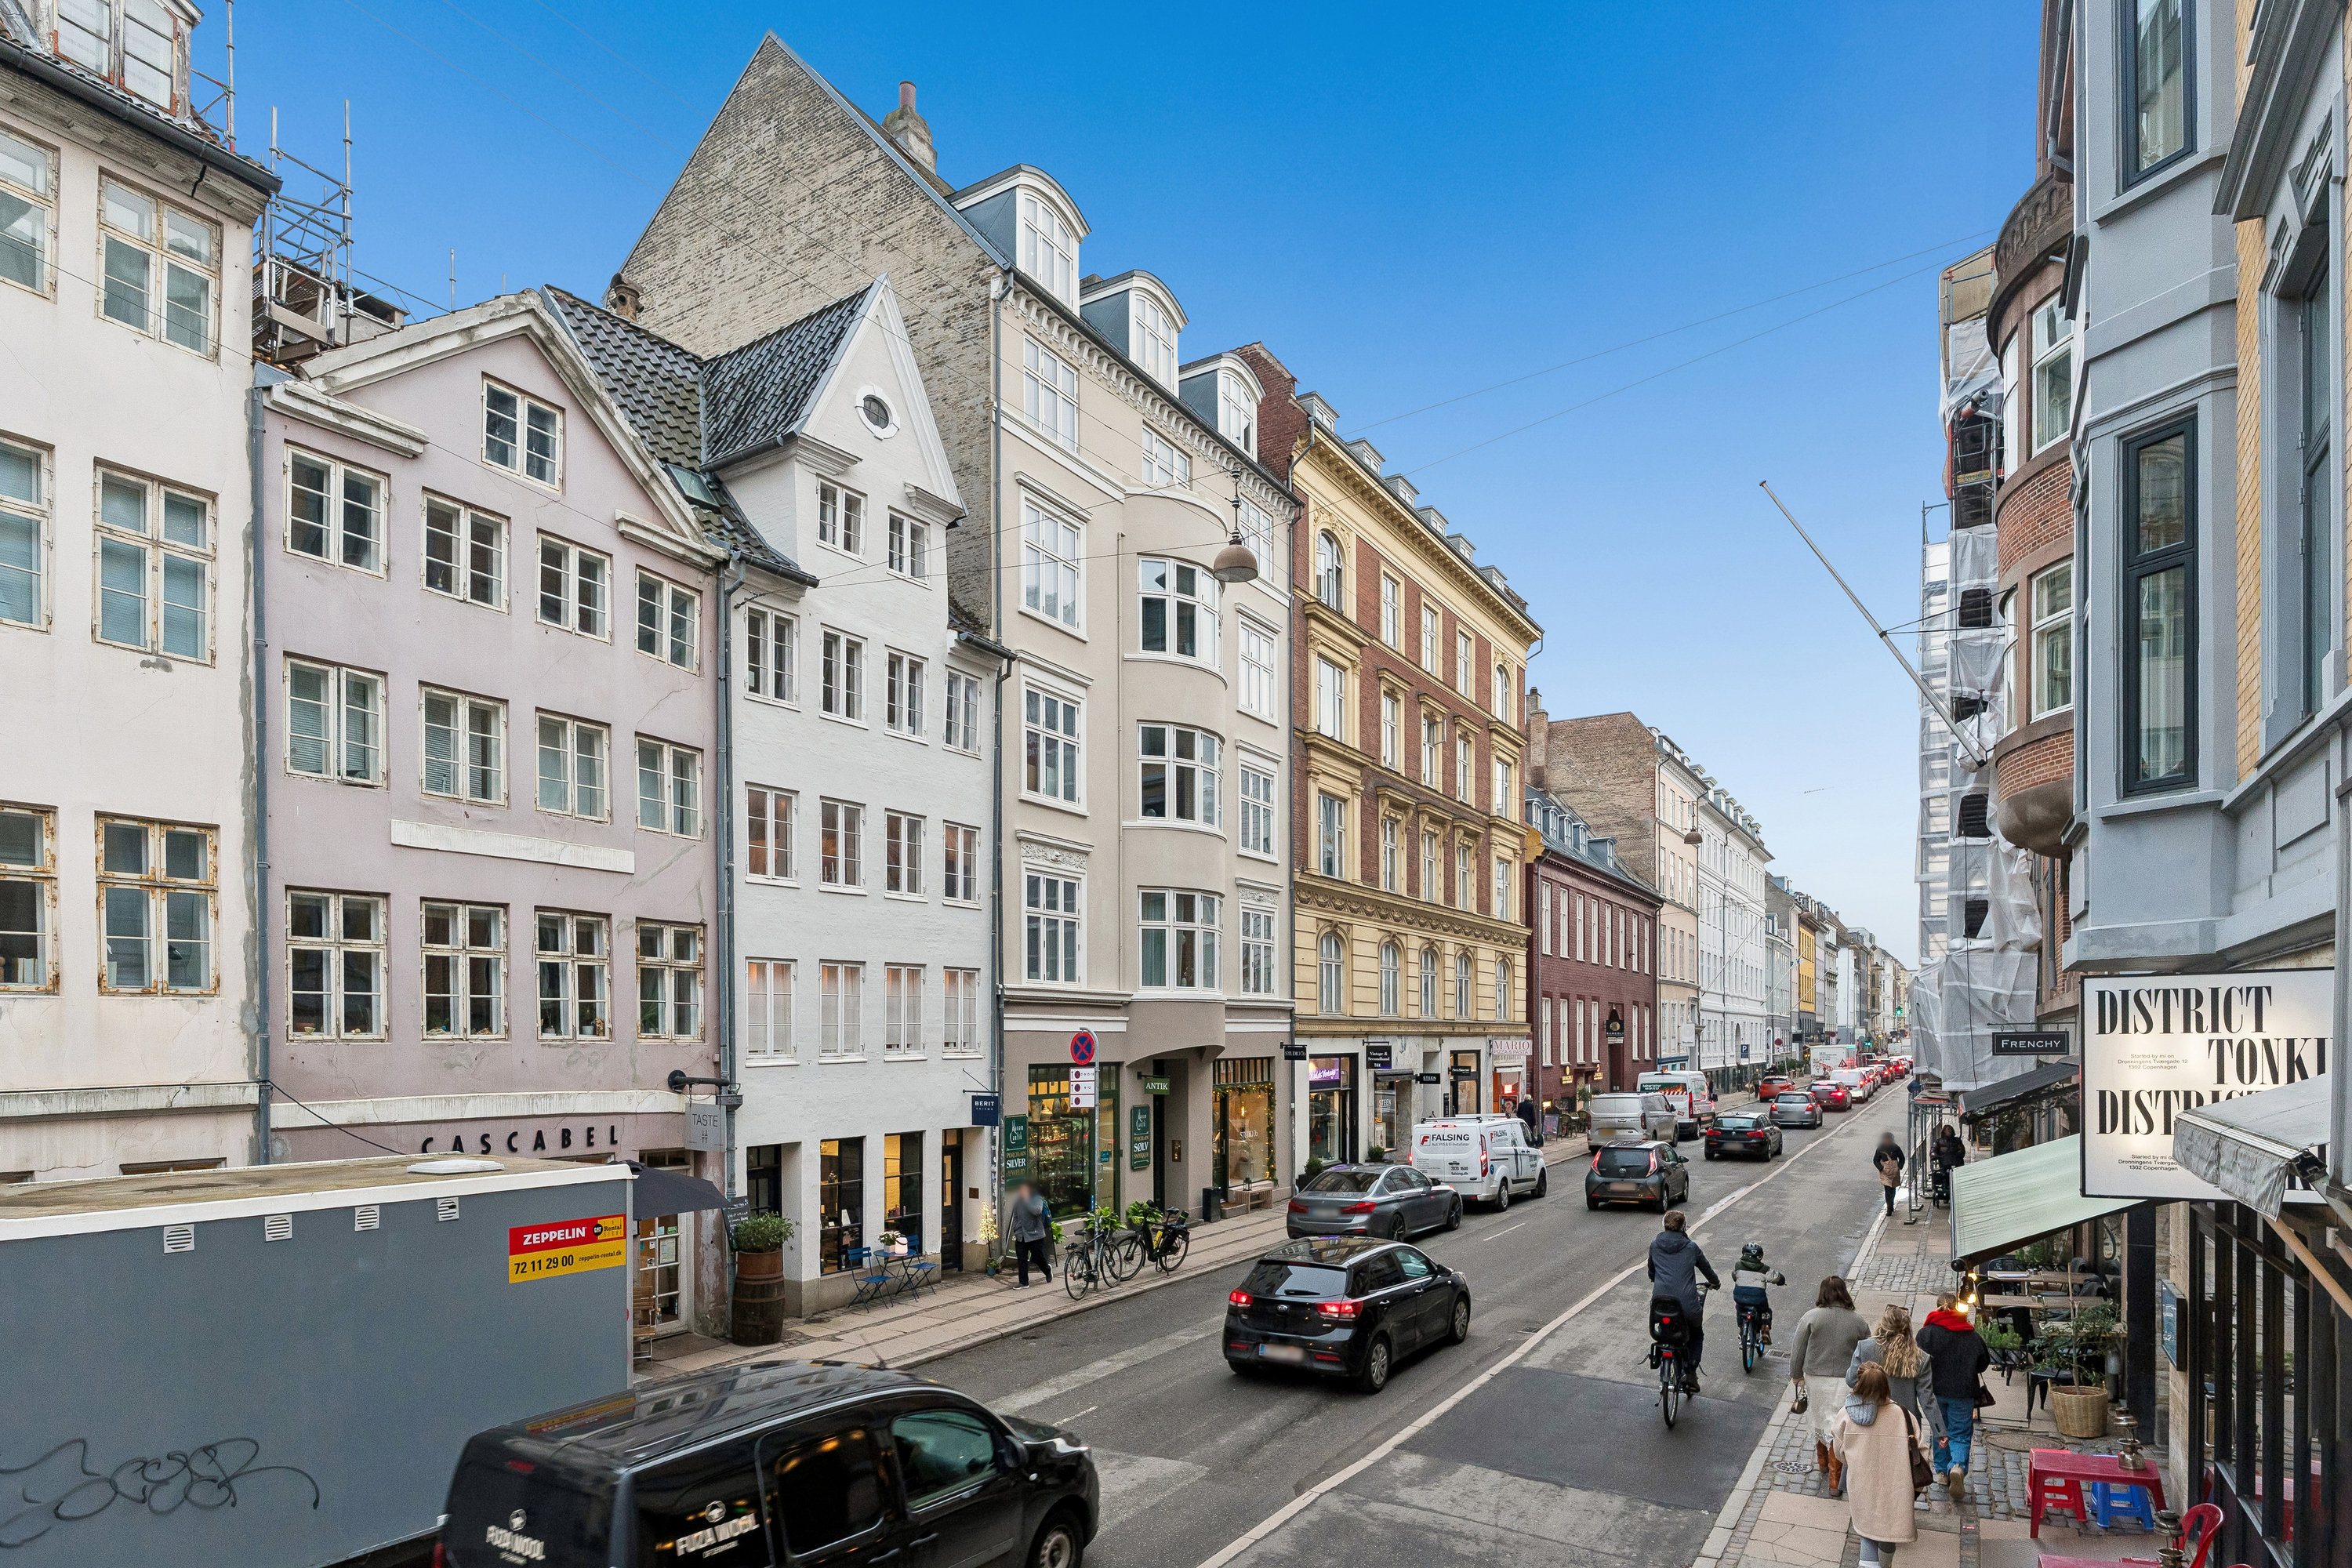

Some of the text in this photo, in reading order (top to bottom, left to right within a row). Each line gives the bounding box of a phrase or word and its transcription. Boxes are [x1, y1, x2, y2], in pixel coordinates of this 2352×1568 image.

[2096, 986, 2272, 1035] DISTRICT
[1494, 1040, 1530, 1050] MARIO
[2002, 1040, 2060, 1048] FRENCHY
[2208, 1037, 2333, 1085] TONKI
[692, 1113, 718, 1127] TASTE
[422, 1125, 619, 1155] CASCABEL
[1134, 1142, 1149, 1152] SØLV
[1006, 1158, 1026, 1169] SILVER
[523, 1226, 586, 1246] ZEPPELIN
[514, 1250, 622, 1275] 72 11 29 00 zeppelin-rental.dk
